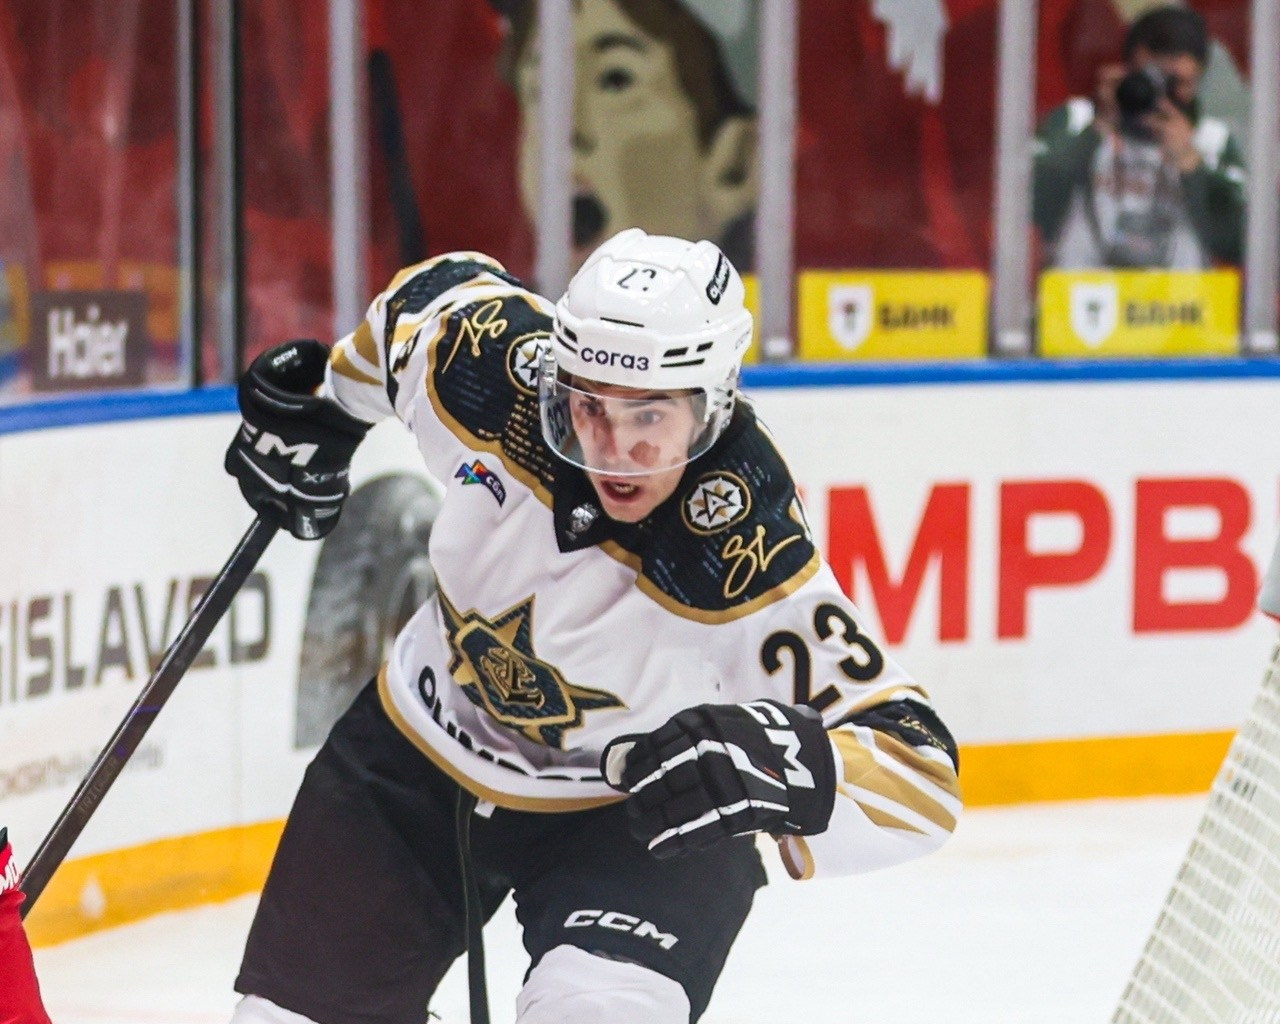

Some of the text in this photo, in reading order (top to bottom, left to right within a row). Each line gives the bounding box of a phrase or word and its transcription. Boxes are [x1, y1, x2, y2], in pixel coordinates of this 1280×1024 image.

[580, 347, 650, 371] согаз
[796, 476, 1280, 646] MPB
[761, 602, 885, 706] 23
[563, 908, 679, 951] CCM
